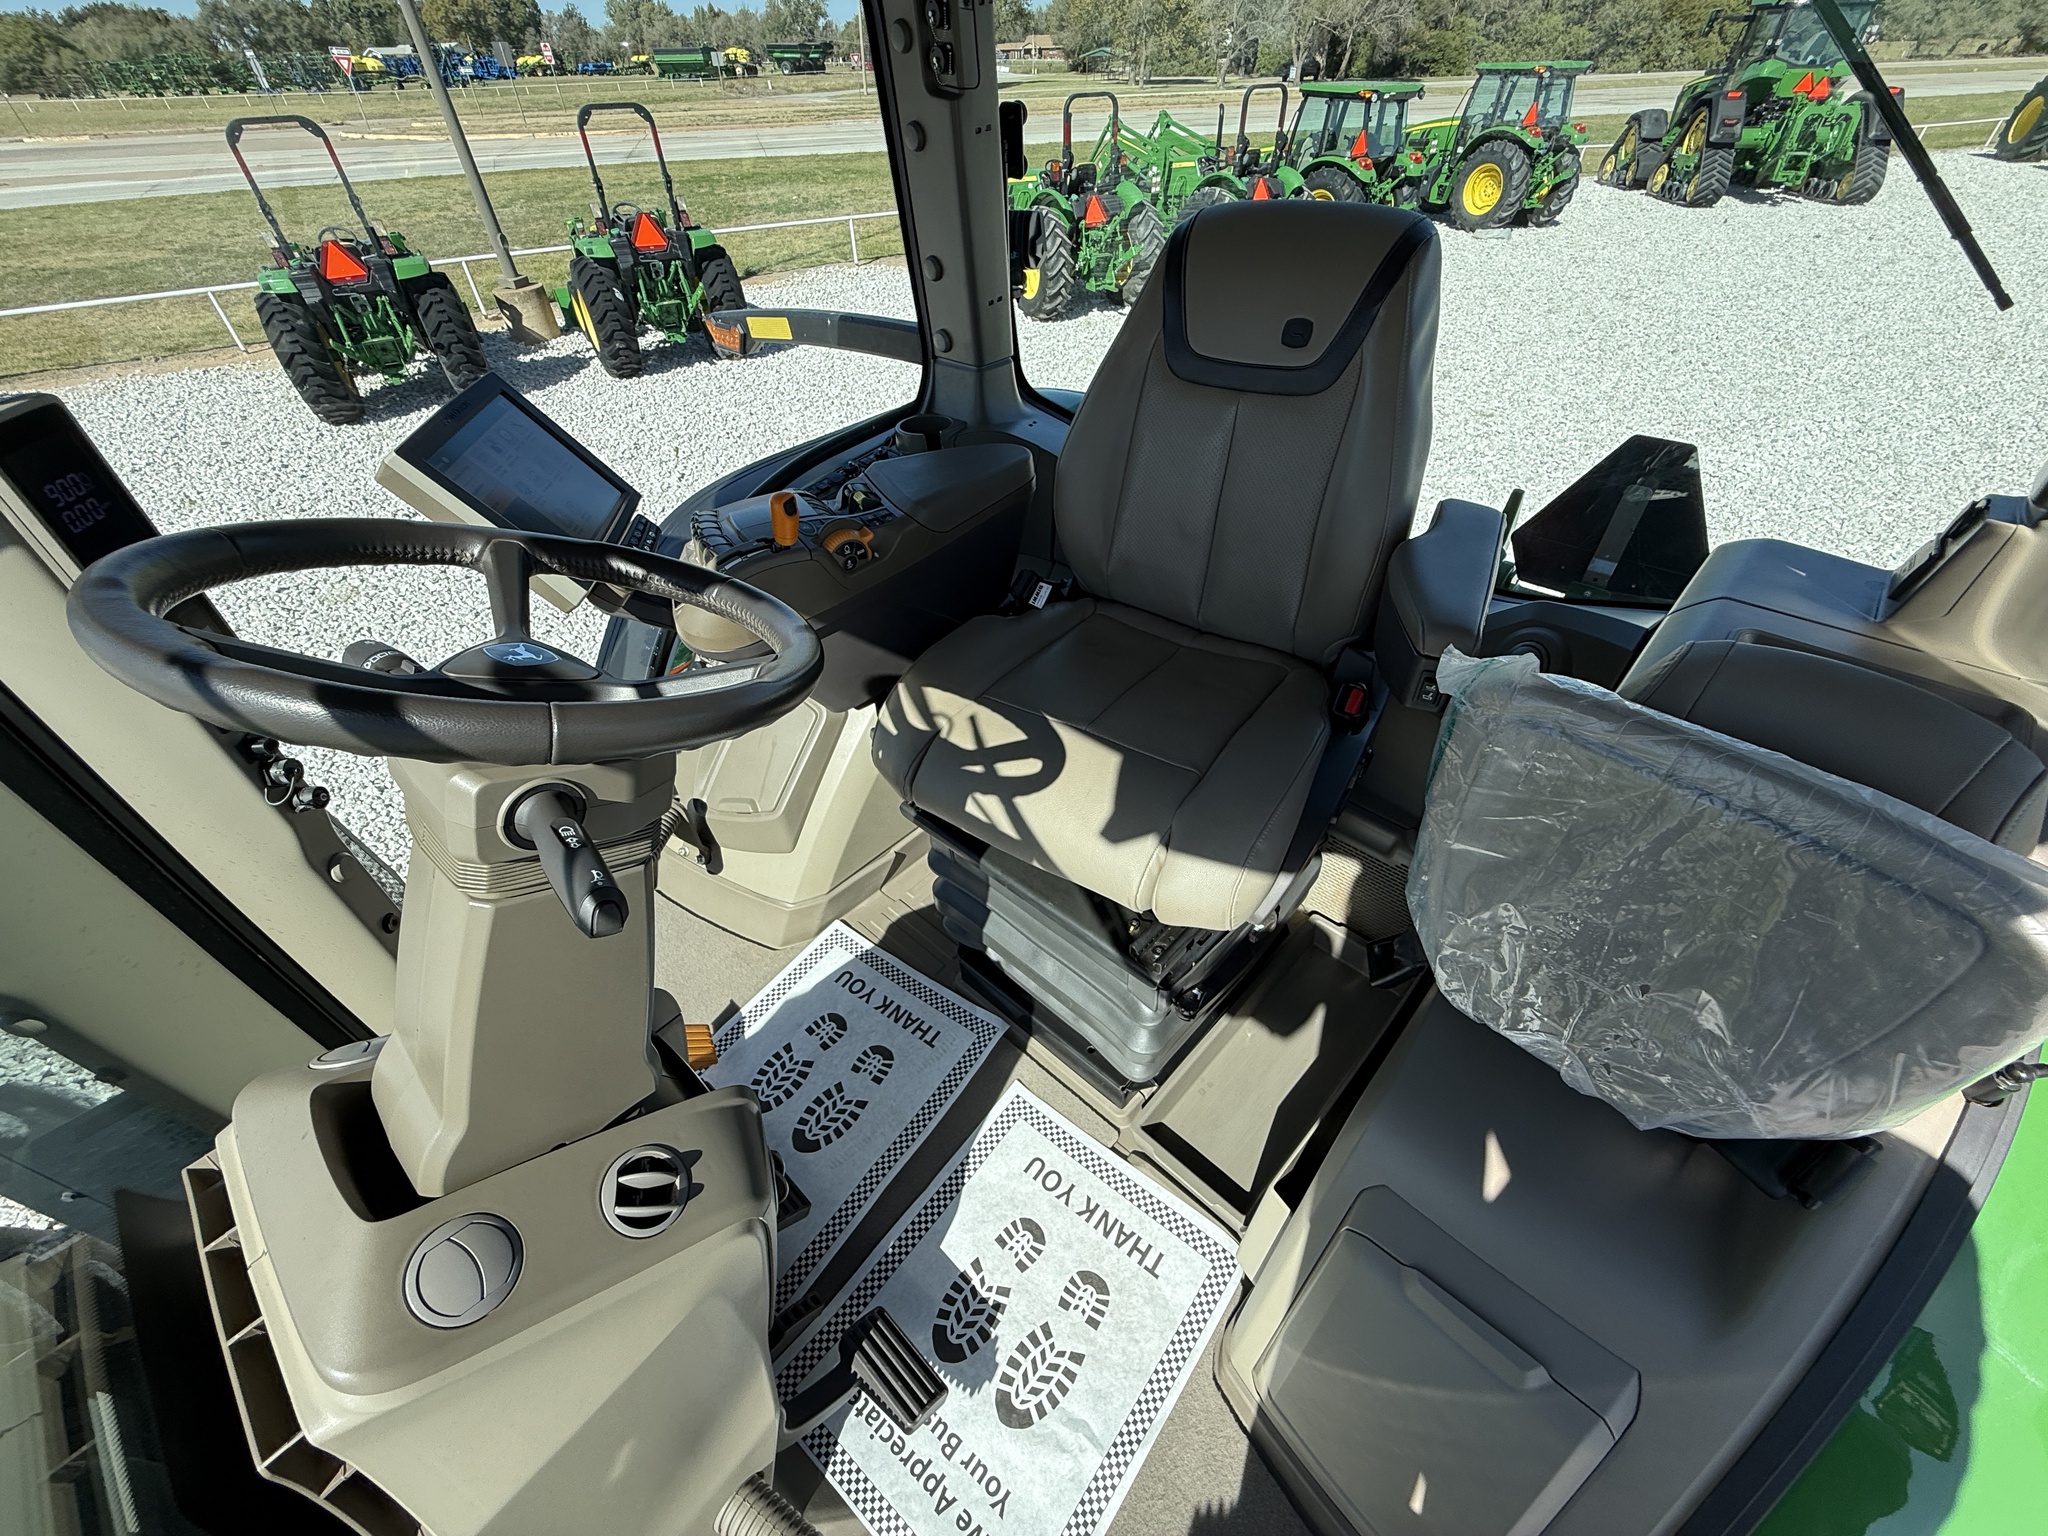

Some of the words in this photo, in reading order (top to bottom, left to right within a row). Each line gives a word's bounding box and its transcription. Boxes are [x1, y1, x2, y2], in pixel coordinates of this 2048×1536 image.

[834, 970, 877, 1005] YOU
[873, 994, 941, 1049] THANK
[1023, 1157, 1076, 1207] YOU
[1075, 1194, 1165, 1280] THANK
[959, 1452, 1011, 1520] Your
